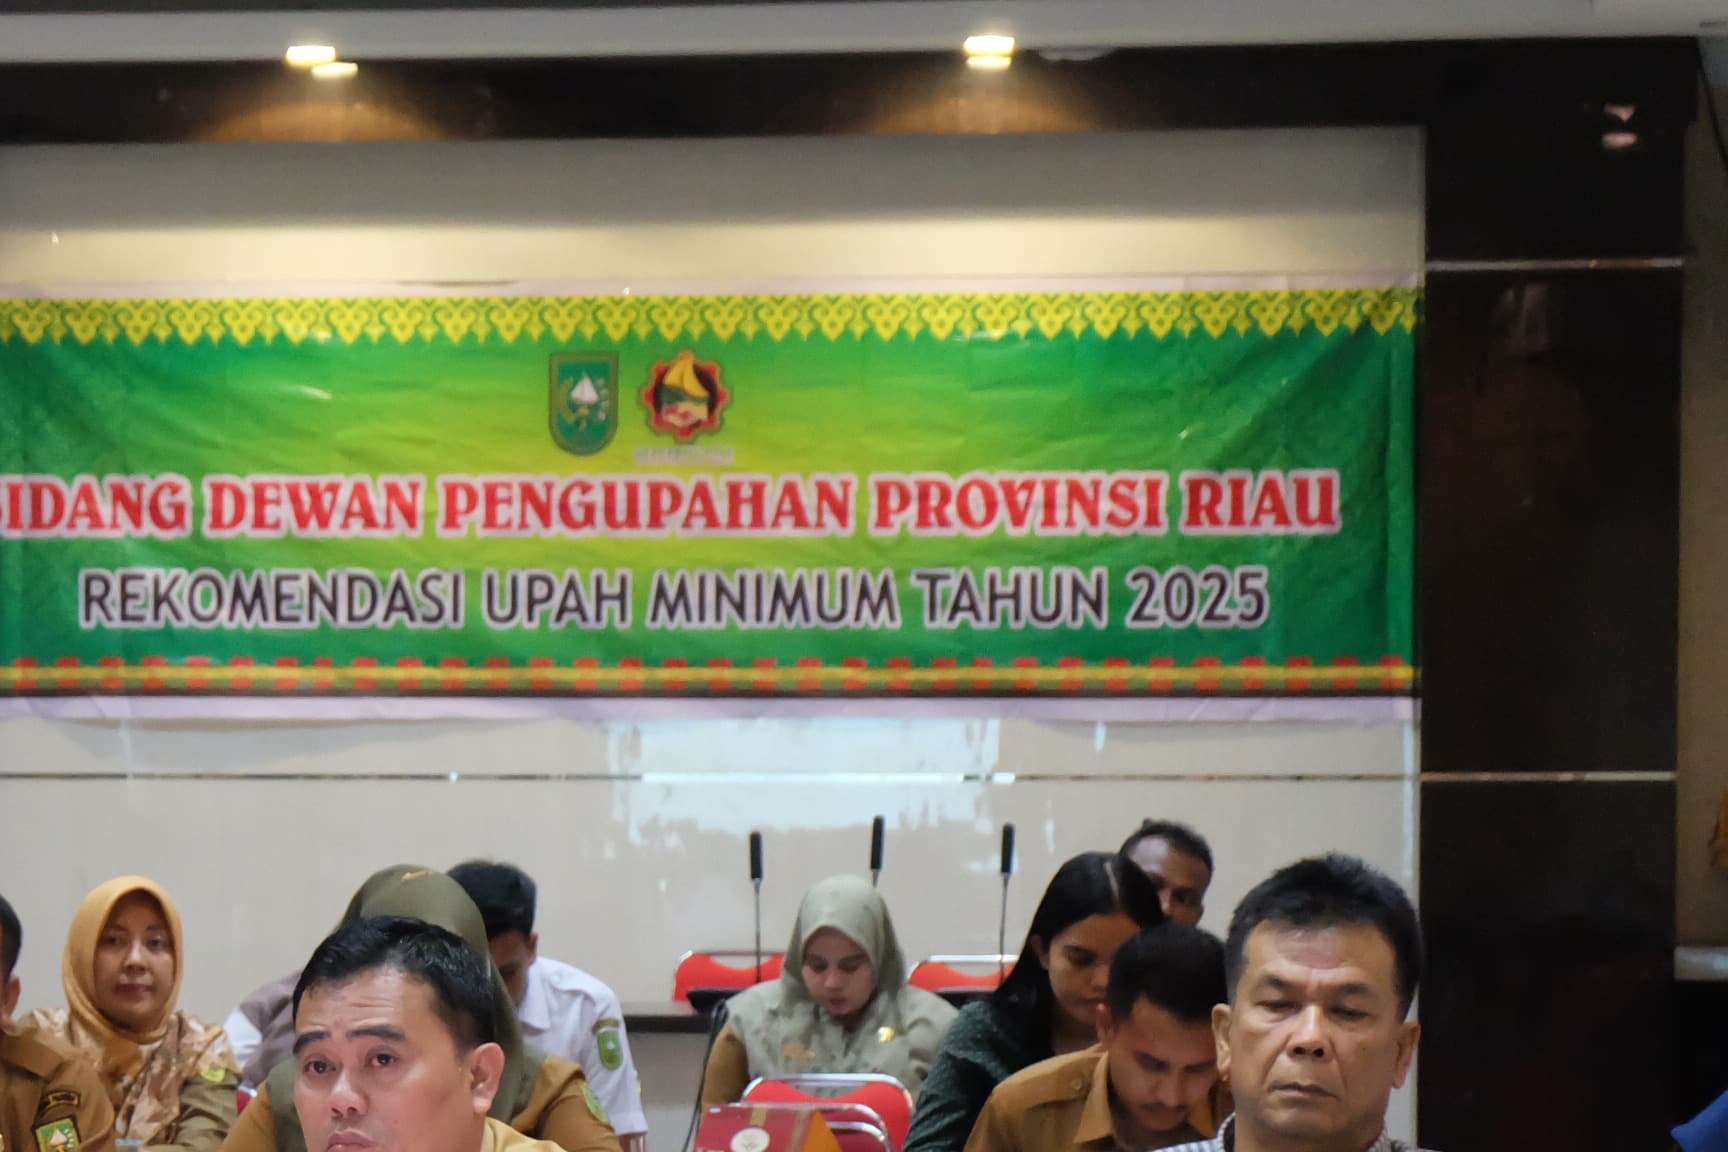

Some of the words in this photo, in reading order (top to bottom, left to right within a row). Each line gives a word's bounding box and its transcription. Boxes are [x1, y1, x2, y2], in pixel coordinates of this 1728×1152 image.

[206, 477, 421, 535] DEWAN
[441, 475, 852, 534] PENGUPAHAN
[872, 473, 1163, 533] PROVINSI
[1182, 472, 1338, 532] RIAU
[81, 570, 461, 626] REKOMENDASI
[484, 570, 629, 626] UPAH
[649, 570, 897, 626] MINIMUM
[913, 570, 1107, 626] TAHUN
[1128, 569, 1270, 626] 2025
